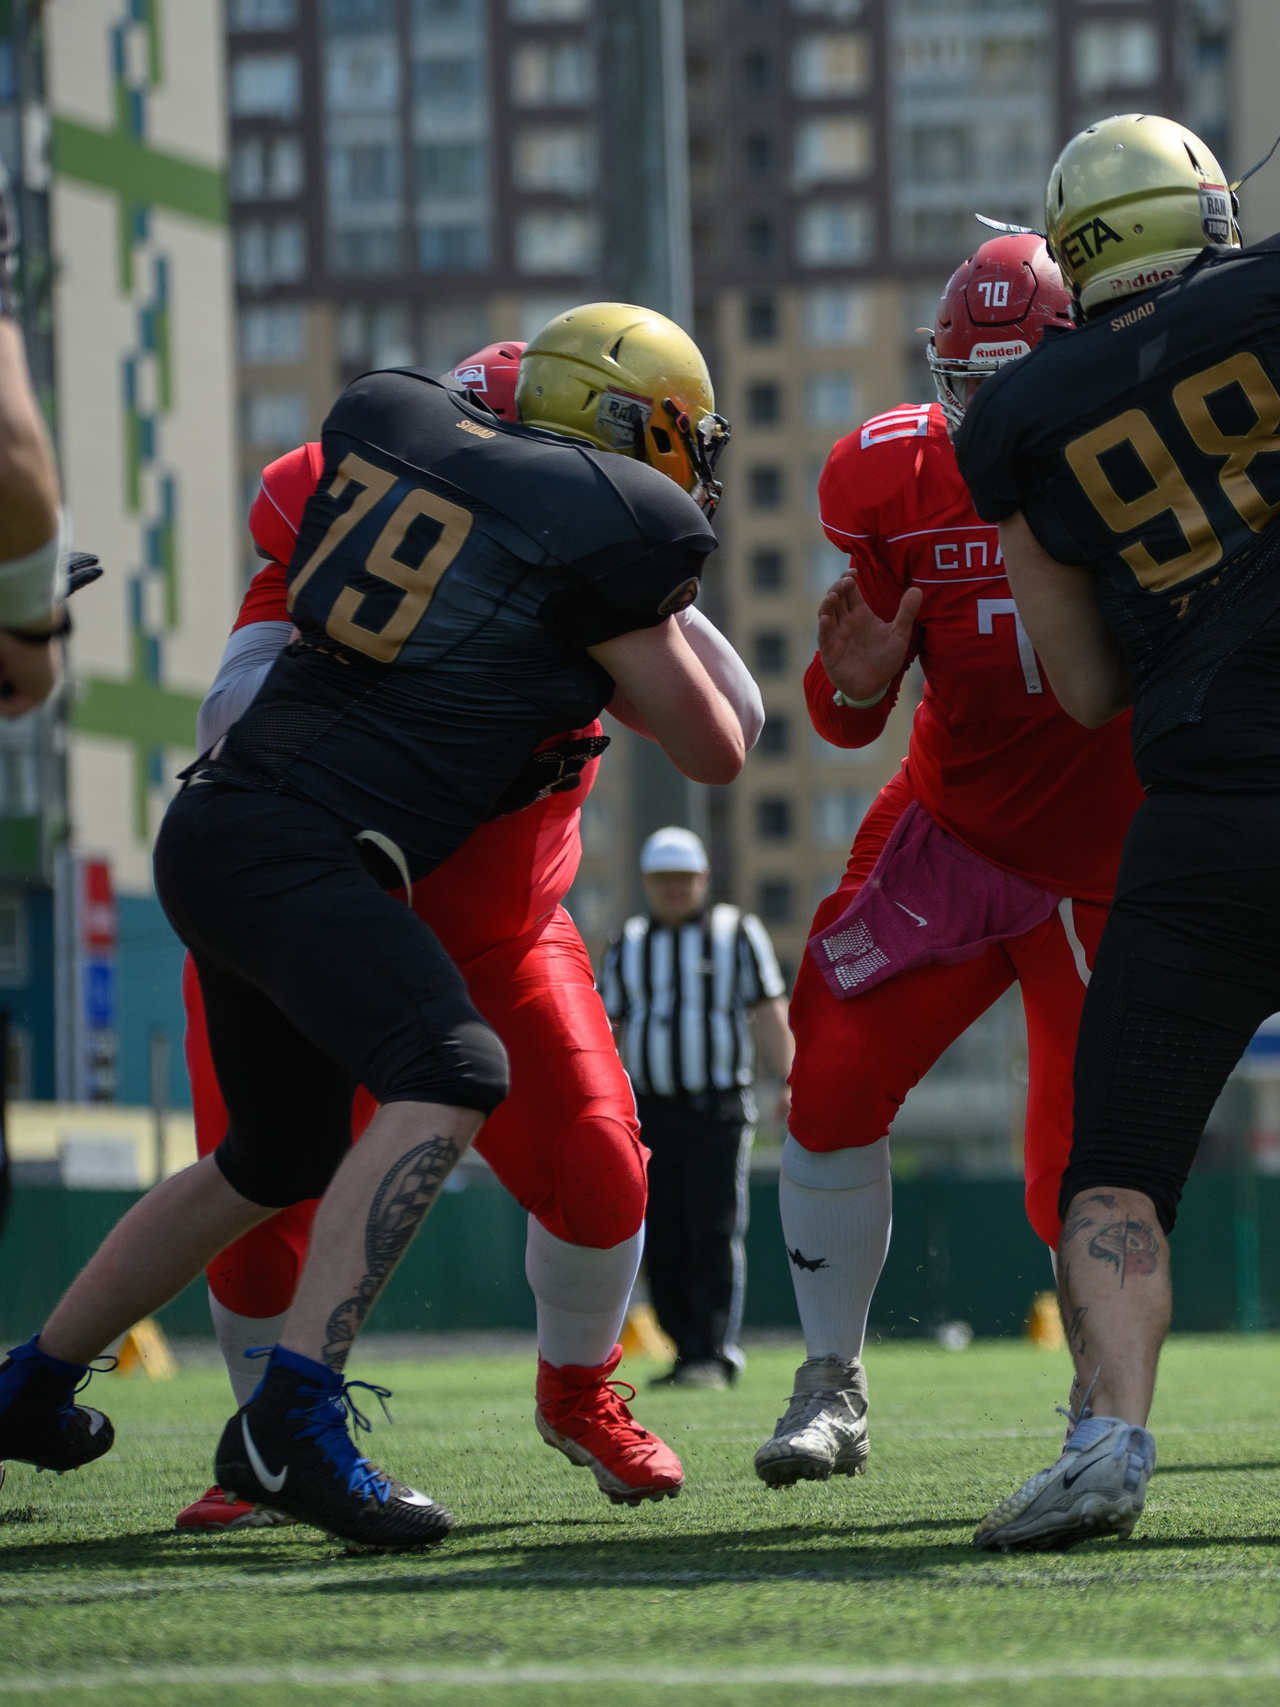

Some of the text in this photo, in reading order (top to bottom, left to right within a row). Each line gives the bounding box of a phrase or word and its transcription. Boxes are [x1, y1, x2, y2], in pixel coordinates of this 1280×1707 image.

[1206, 196, 1227, 217] RAM
[978, 281, 1010, 308] 70
[286, 452, 474, 663] 79
